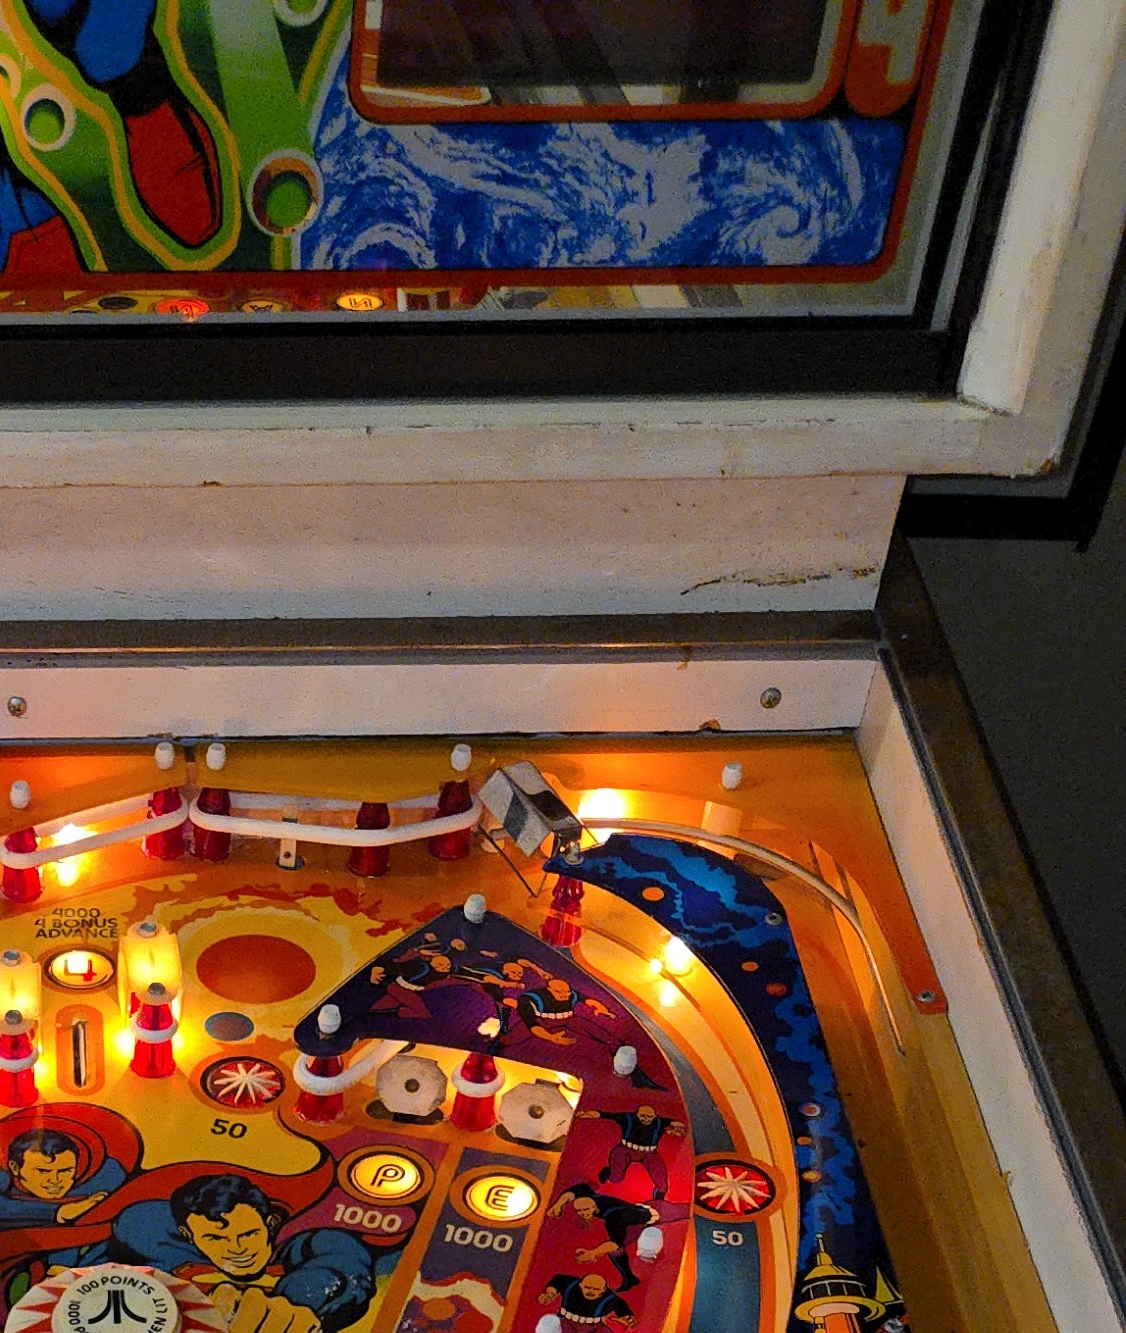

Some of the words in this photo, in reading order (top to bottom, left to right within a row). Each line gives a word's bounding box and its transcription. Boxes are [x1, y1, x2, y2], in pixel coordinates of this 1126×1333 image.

[52, 908, 100, 918] 4000
[52, 918, 118, 928] BONUS
[35, 928, 119, 939] ADVANCE
[63, 958, 98, 982] 4
[210, 1118, 248, 1140] 50
[371, 1165, 403, 1189] P
[487, 1181, 510, 1212] E
[334, 1203, 403, 1234] 1000
[444, 1224, 514, 1254] 1000
[712, 1230, 744, 1247] 50
[76, 1281, 100, 1296] 100
[100, 1275, 155, 1296] POINTS
[67, 1300, 81, 1326] 1000
[152, 1297, 168, 1314] LIT
